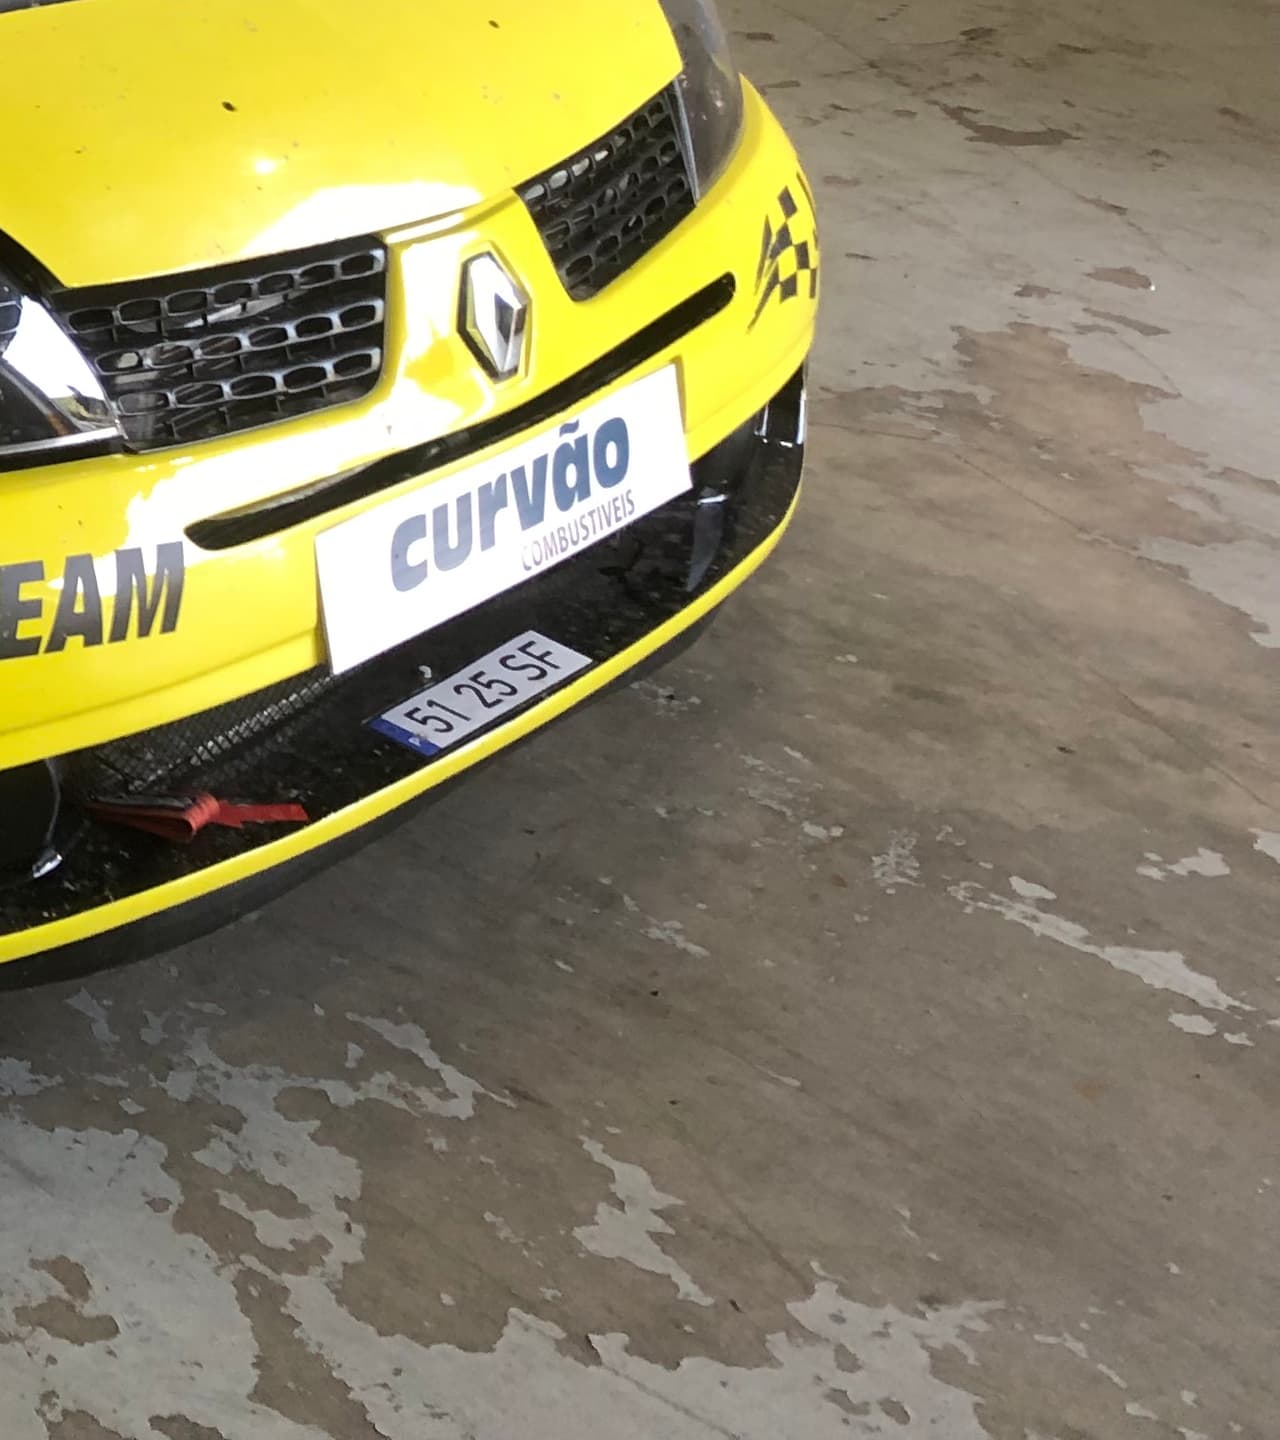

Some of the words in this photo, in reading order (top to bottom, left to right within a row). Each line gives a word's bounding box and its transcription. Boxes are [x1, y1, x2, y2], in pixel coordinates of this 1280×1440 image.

[390, 416, 631, 593] curvão
[403, 699, 472, 734] 51
[453, 670, 518, 709] 25
[499, 640, 561, 681] SF
